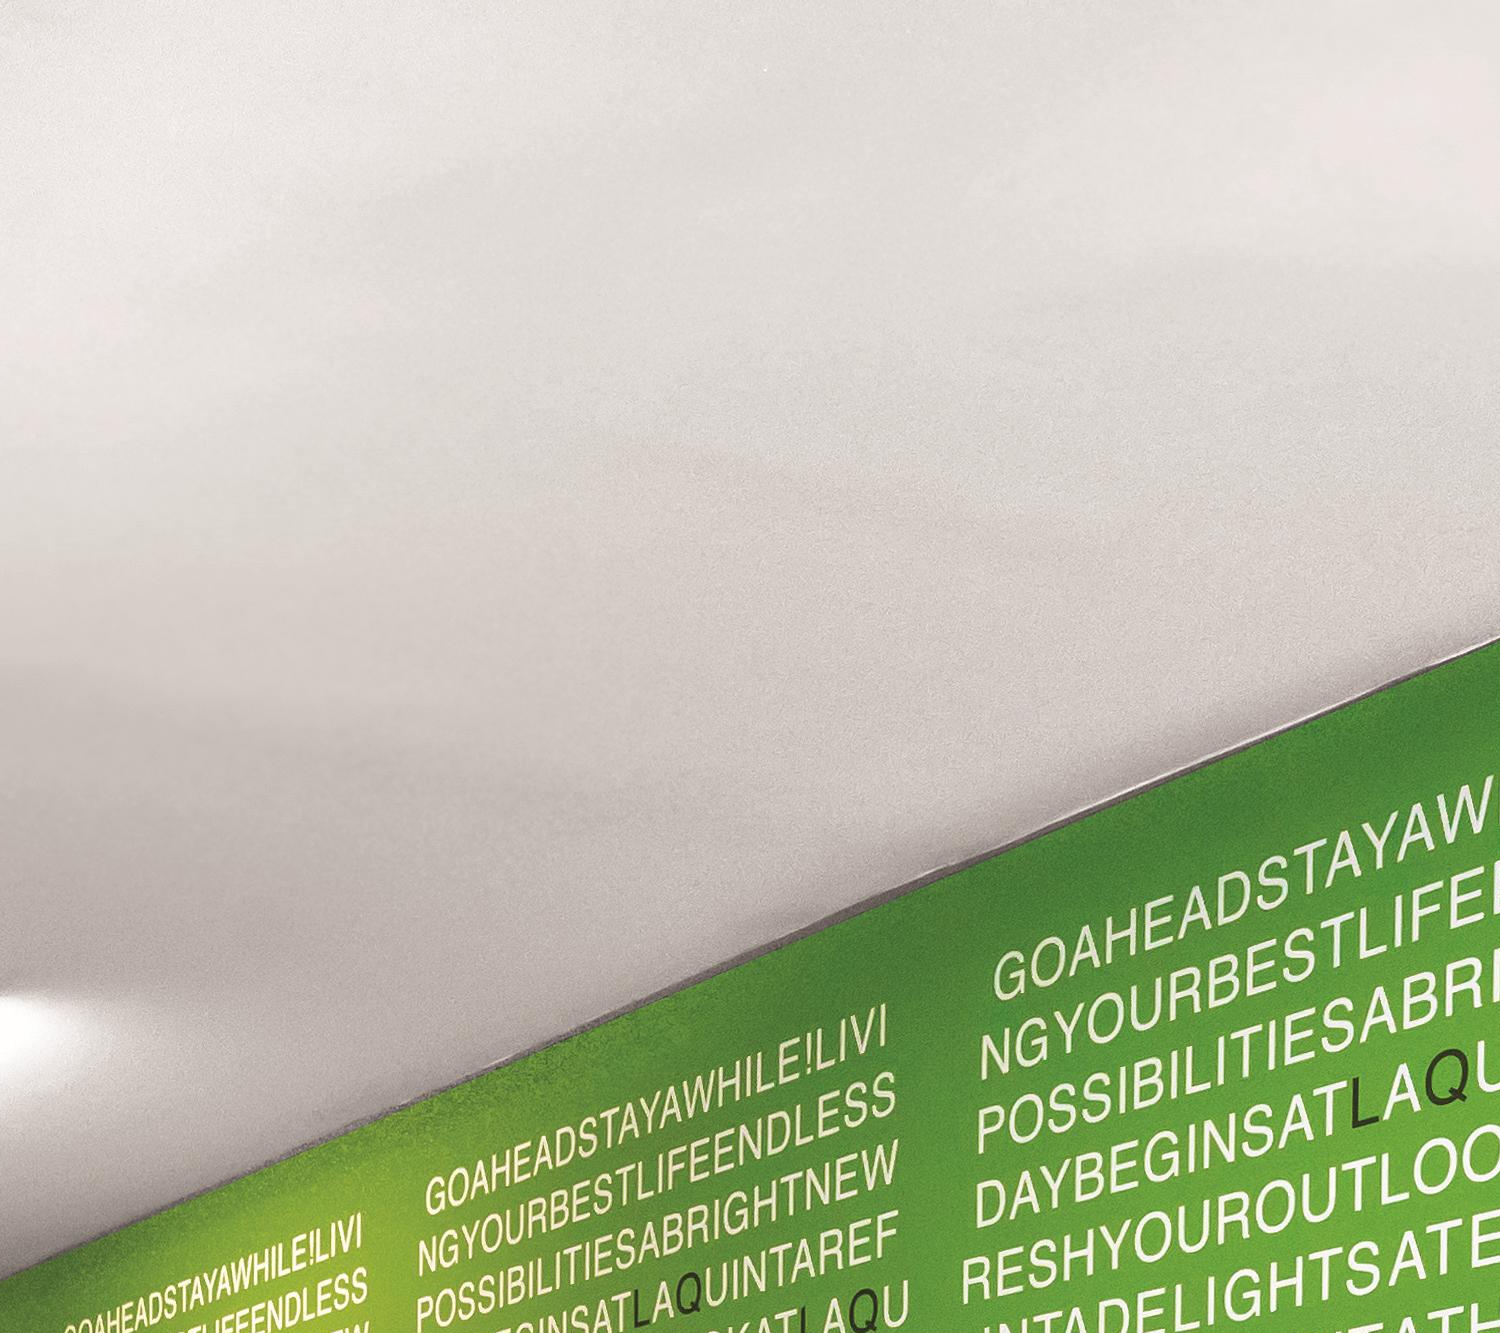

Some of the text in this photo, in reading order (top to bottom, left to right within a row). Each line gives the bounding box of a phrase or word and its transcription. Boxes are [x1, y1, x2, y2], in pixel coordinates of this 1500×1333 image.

[419, 1072, 895, 1276] NGYOURBESTLIFEENDLESS
[426, 1004, 885, 1215] GOAHEADSTAYAWHILE!LIVI
[417, 1139, 898, 1333] POSSIBILITIESABRIGHTNEW
